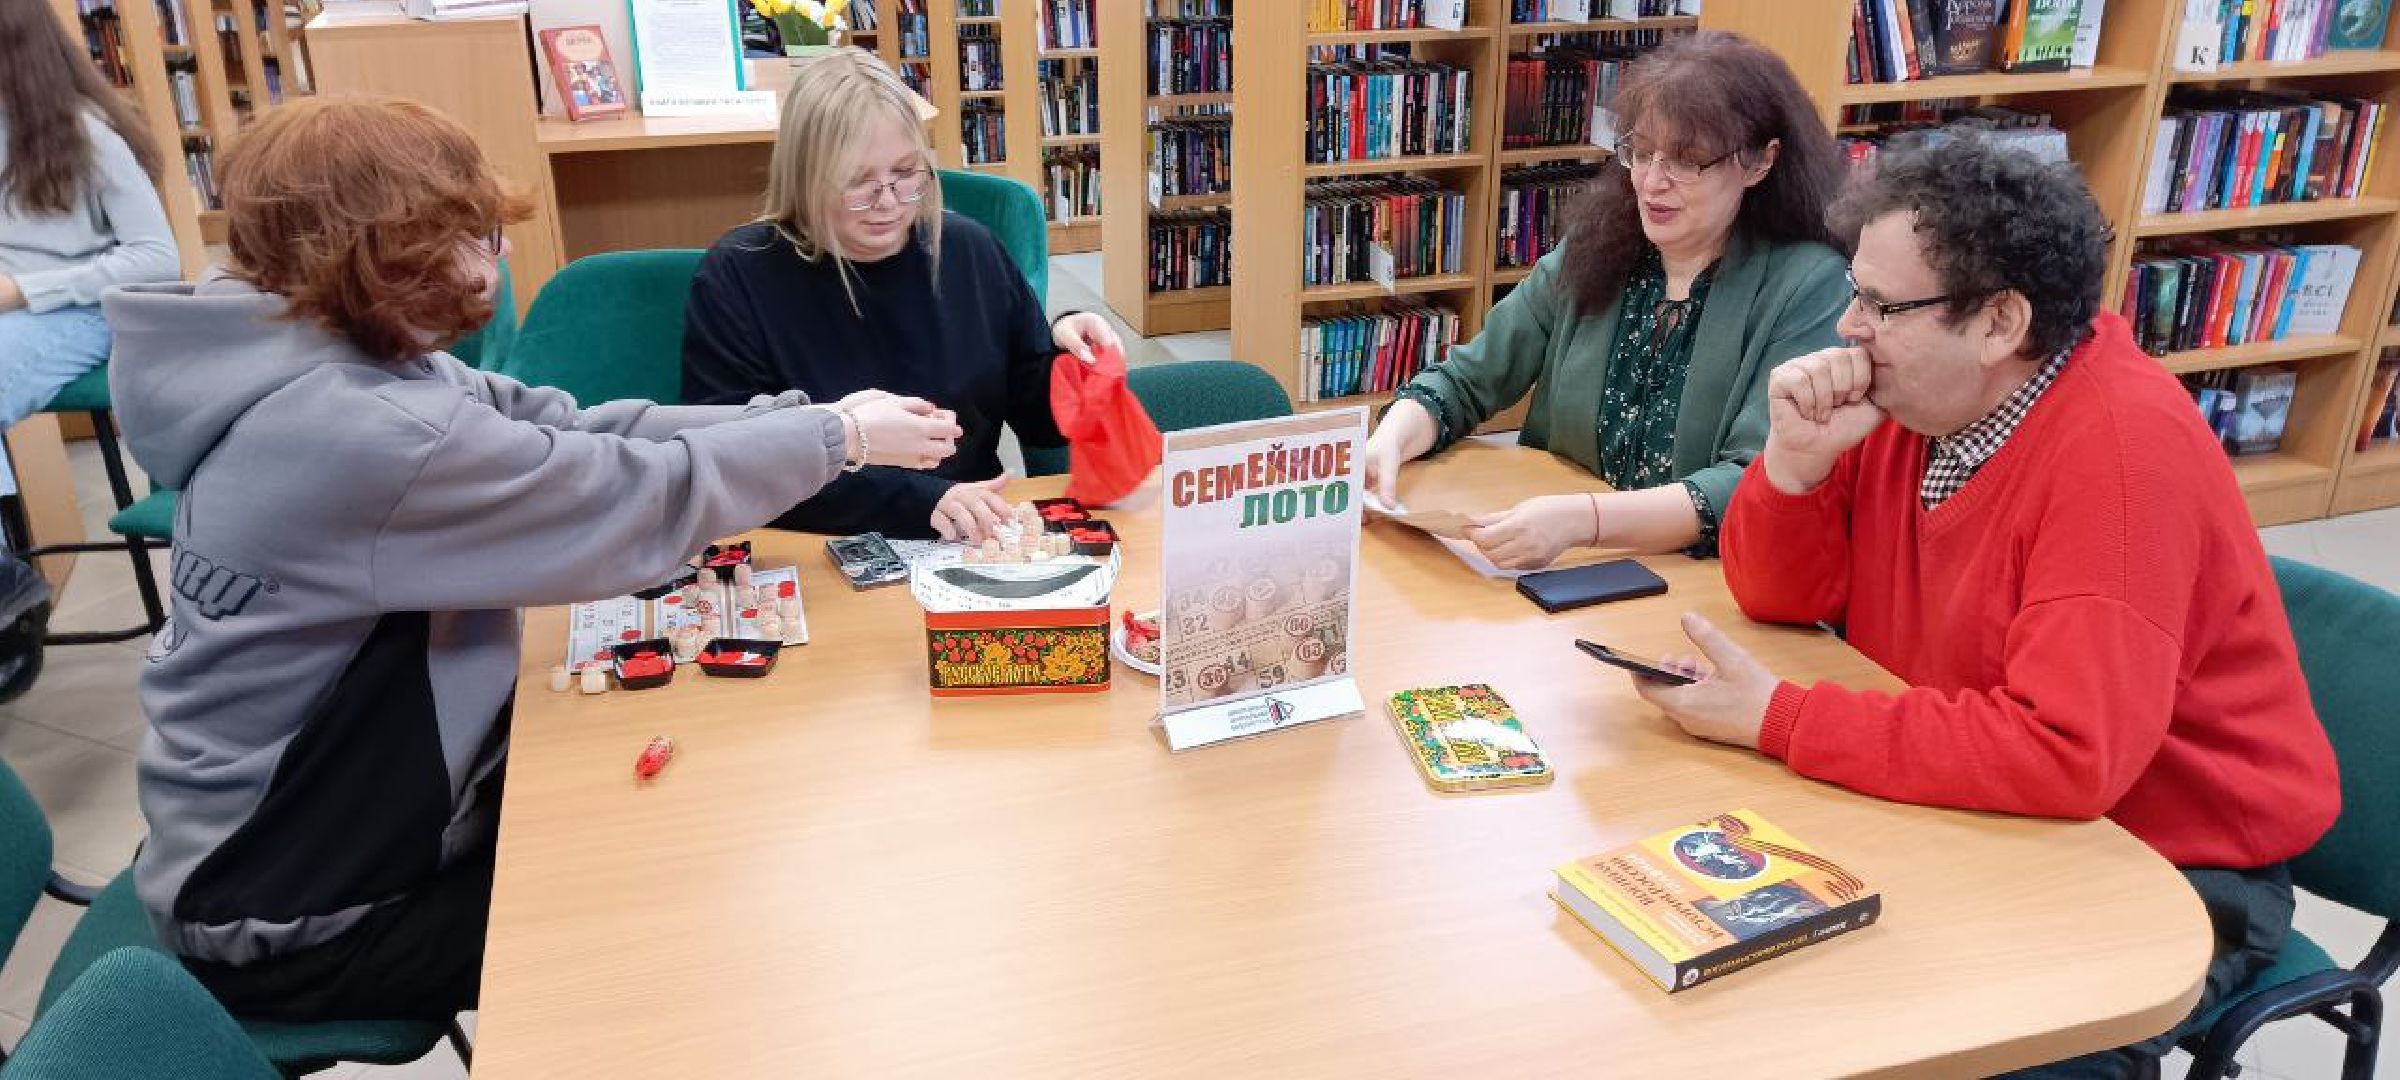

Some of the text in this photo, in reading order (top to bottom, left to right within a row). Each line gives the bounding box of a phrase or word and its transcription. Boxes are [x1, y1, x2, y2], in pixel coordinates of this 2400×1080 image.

[1172, 440, 1351, 508] СЕМЕЙНОЕ
[1240, 480, 1349, 528] ЛОТО
[1182, 614, 1209, 636] 32
[1259, 665, 1285, 689] 59
